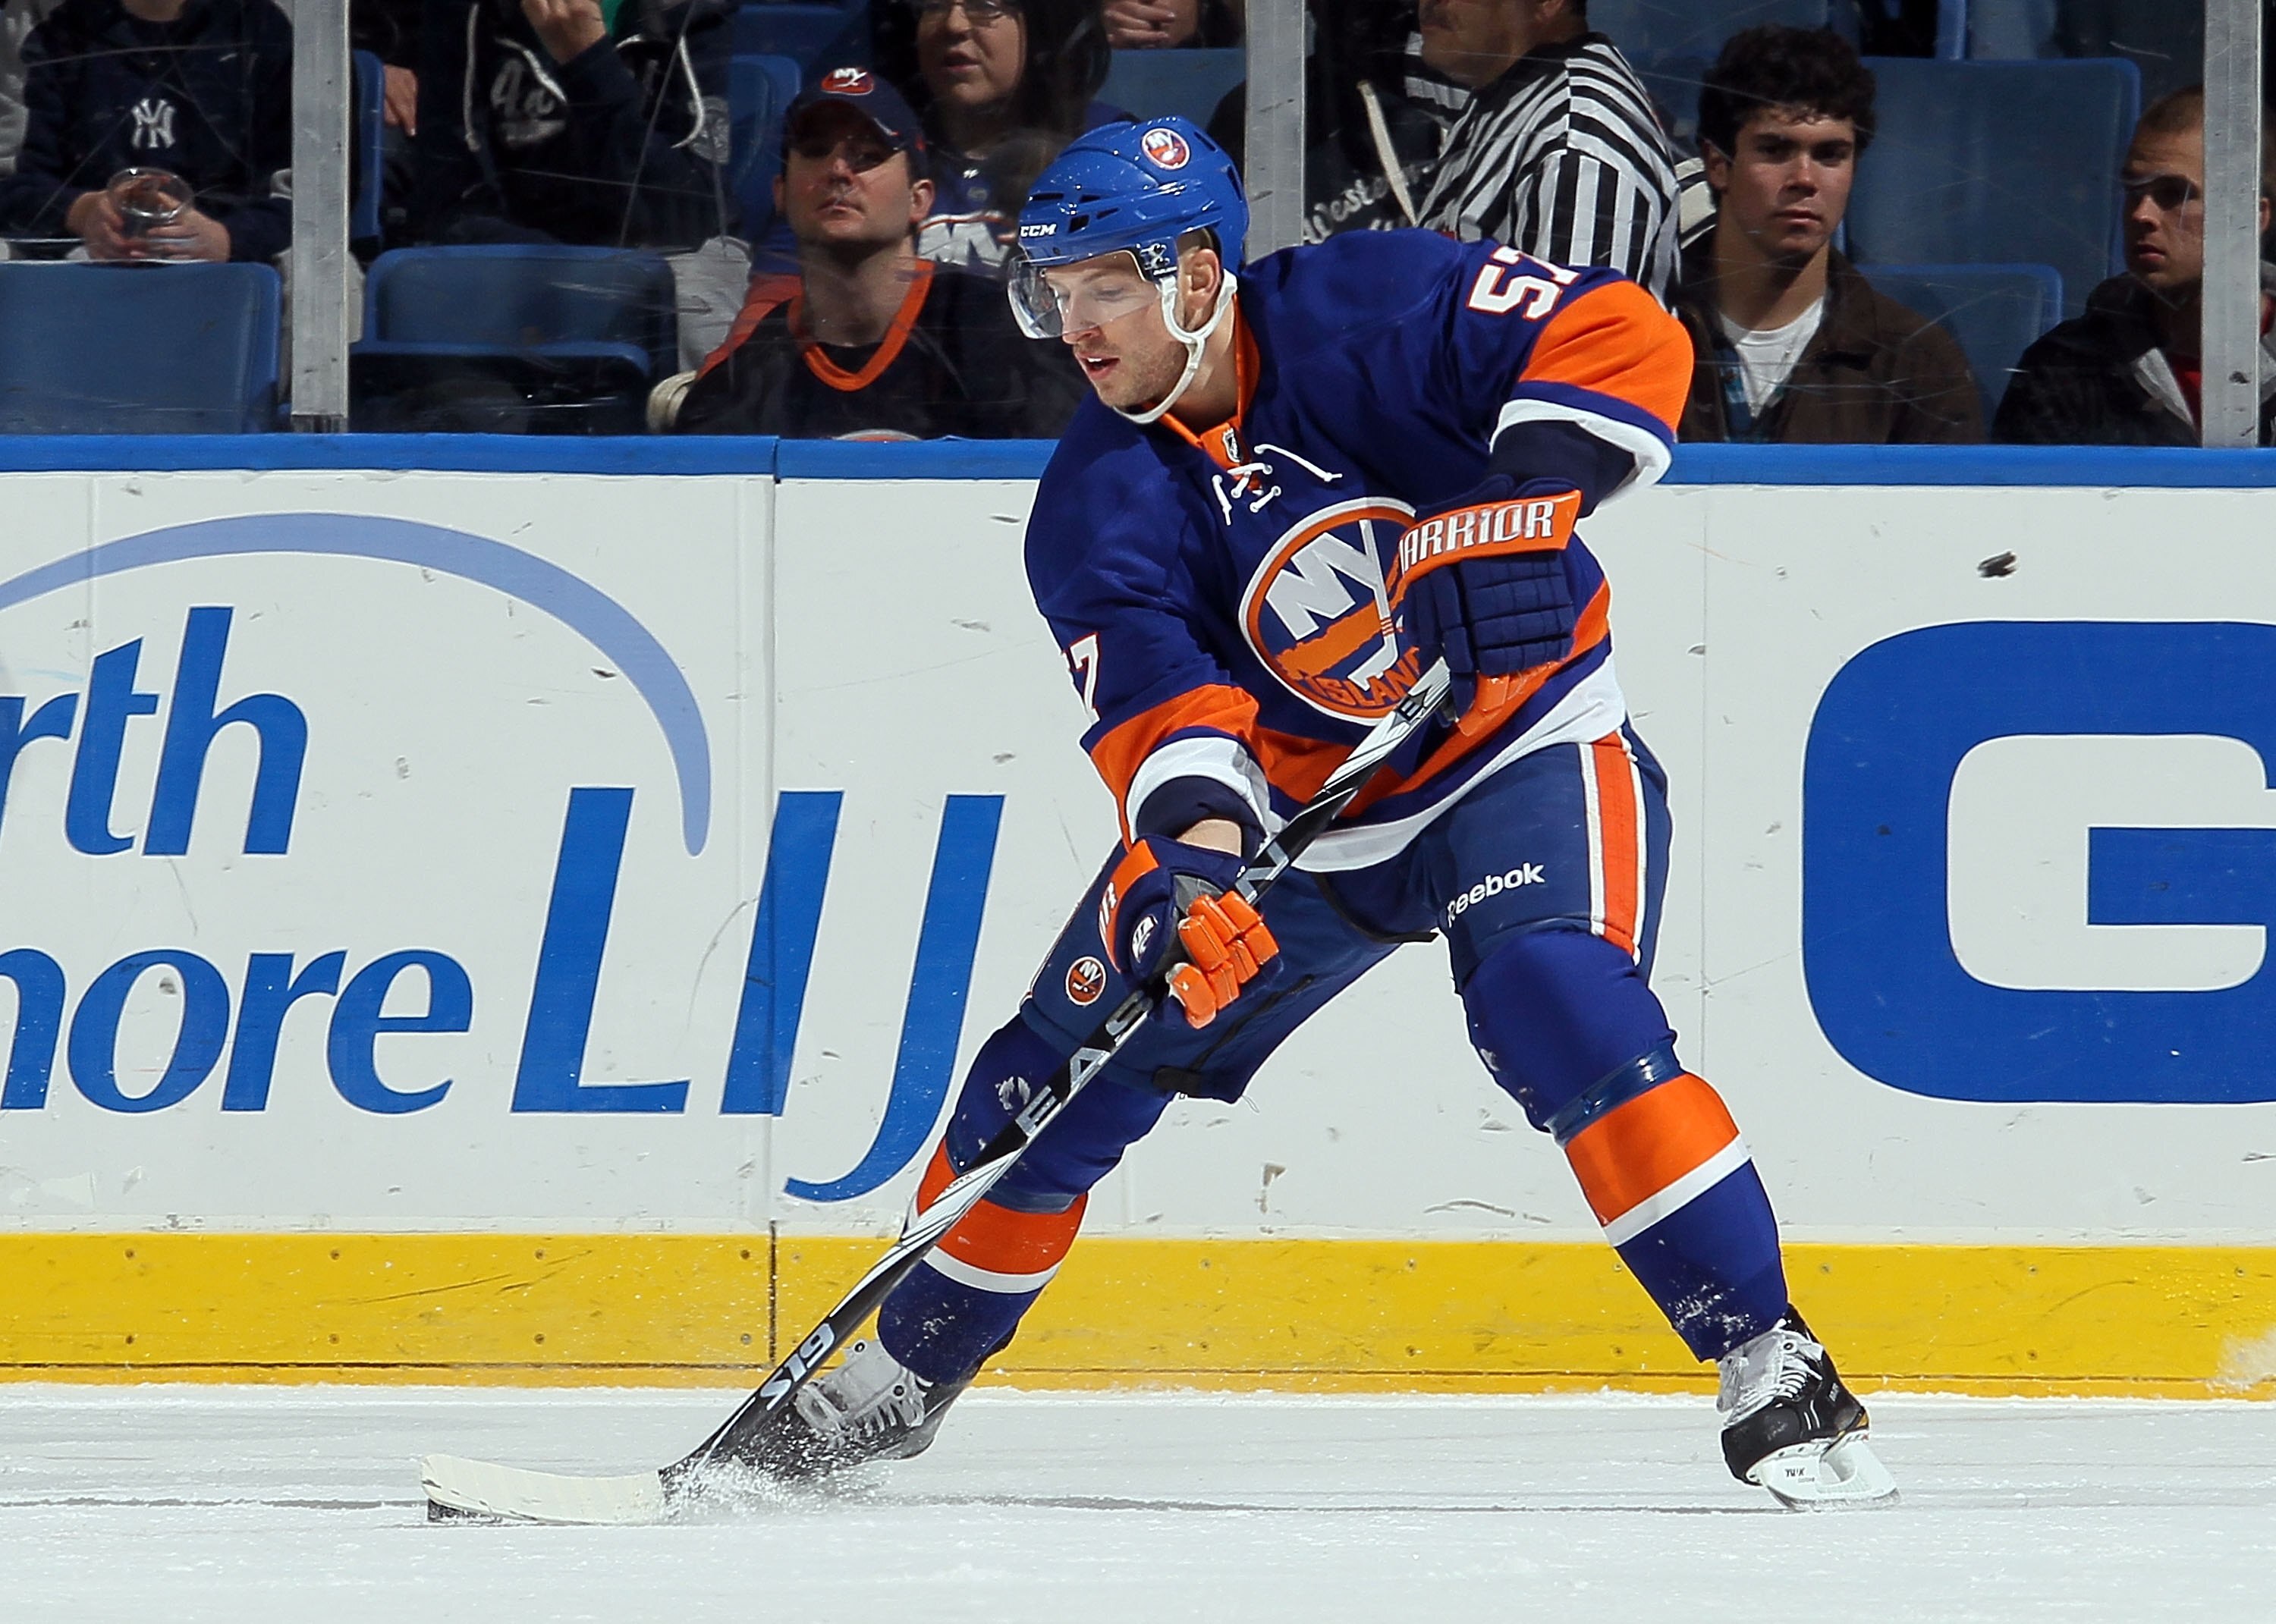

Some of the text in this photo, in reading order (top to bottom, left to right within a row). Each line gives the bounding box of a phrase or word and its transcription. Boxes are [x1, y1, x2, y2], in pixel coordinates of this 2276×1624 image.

[1020, 223, 1057, 237] CCM
[510, 787, 1005, 1203] LIJ
[1015, 842, 1289, 1137] EASN
[1447, 862, 1545, 928] Reebok
[1803, 620, 2276, 1104] G
